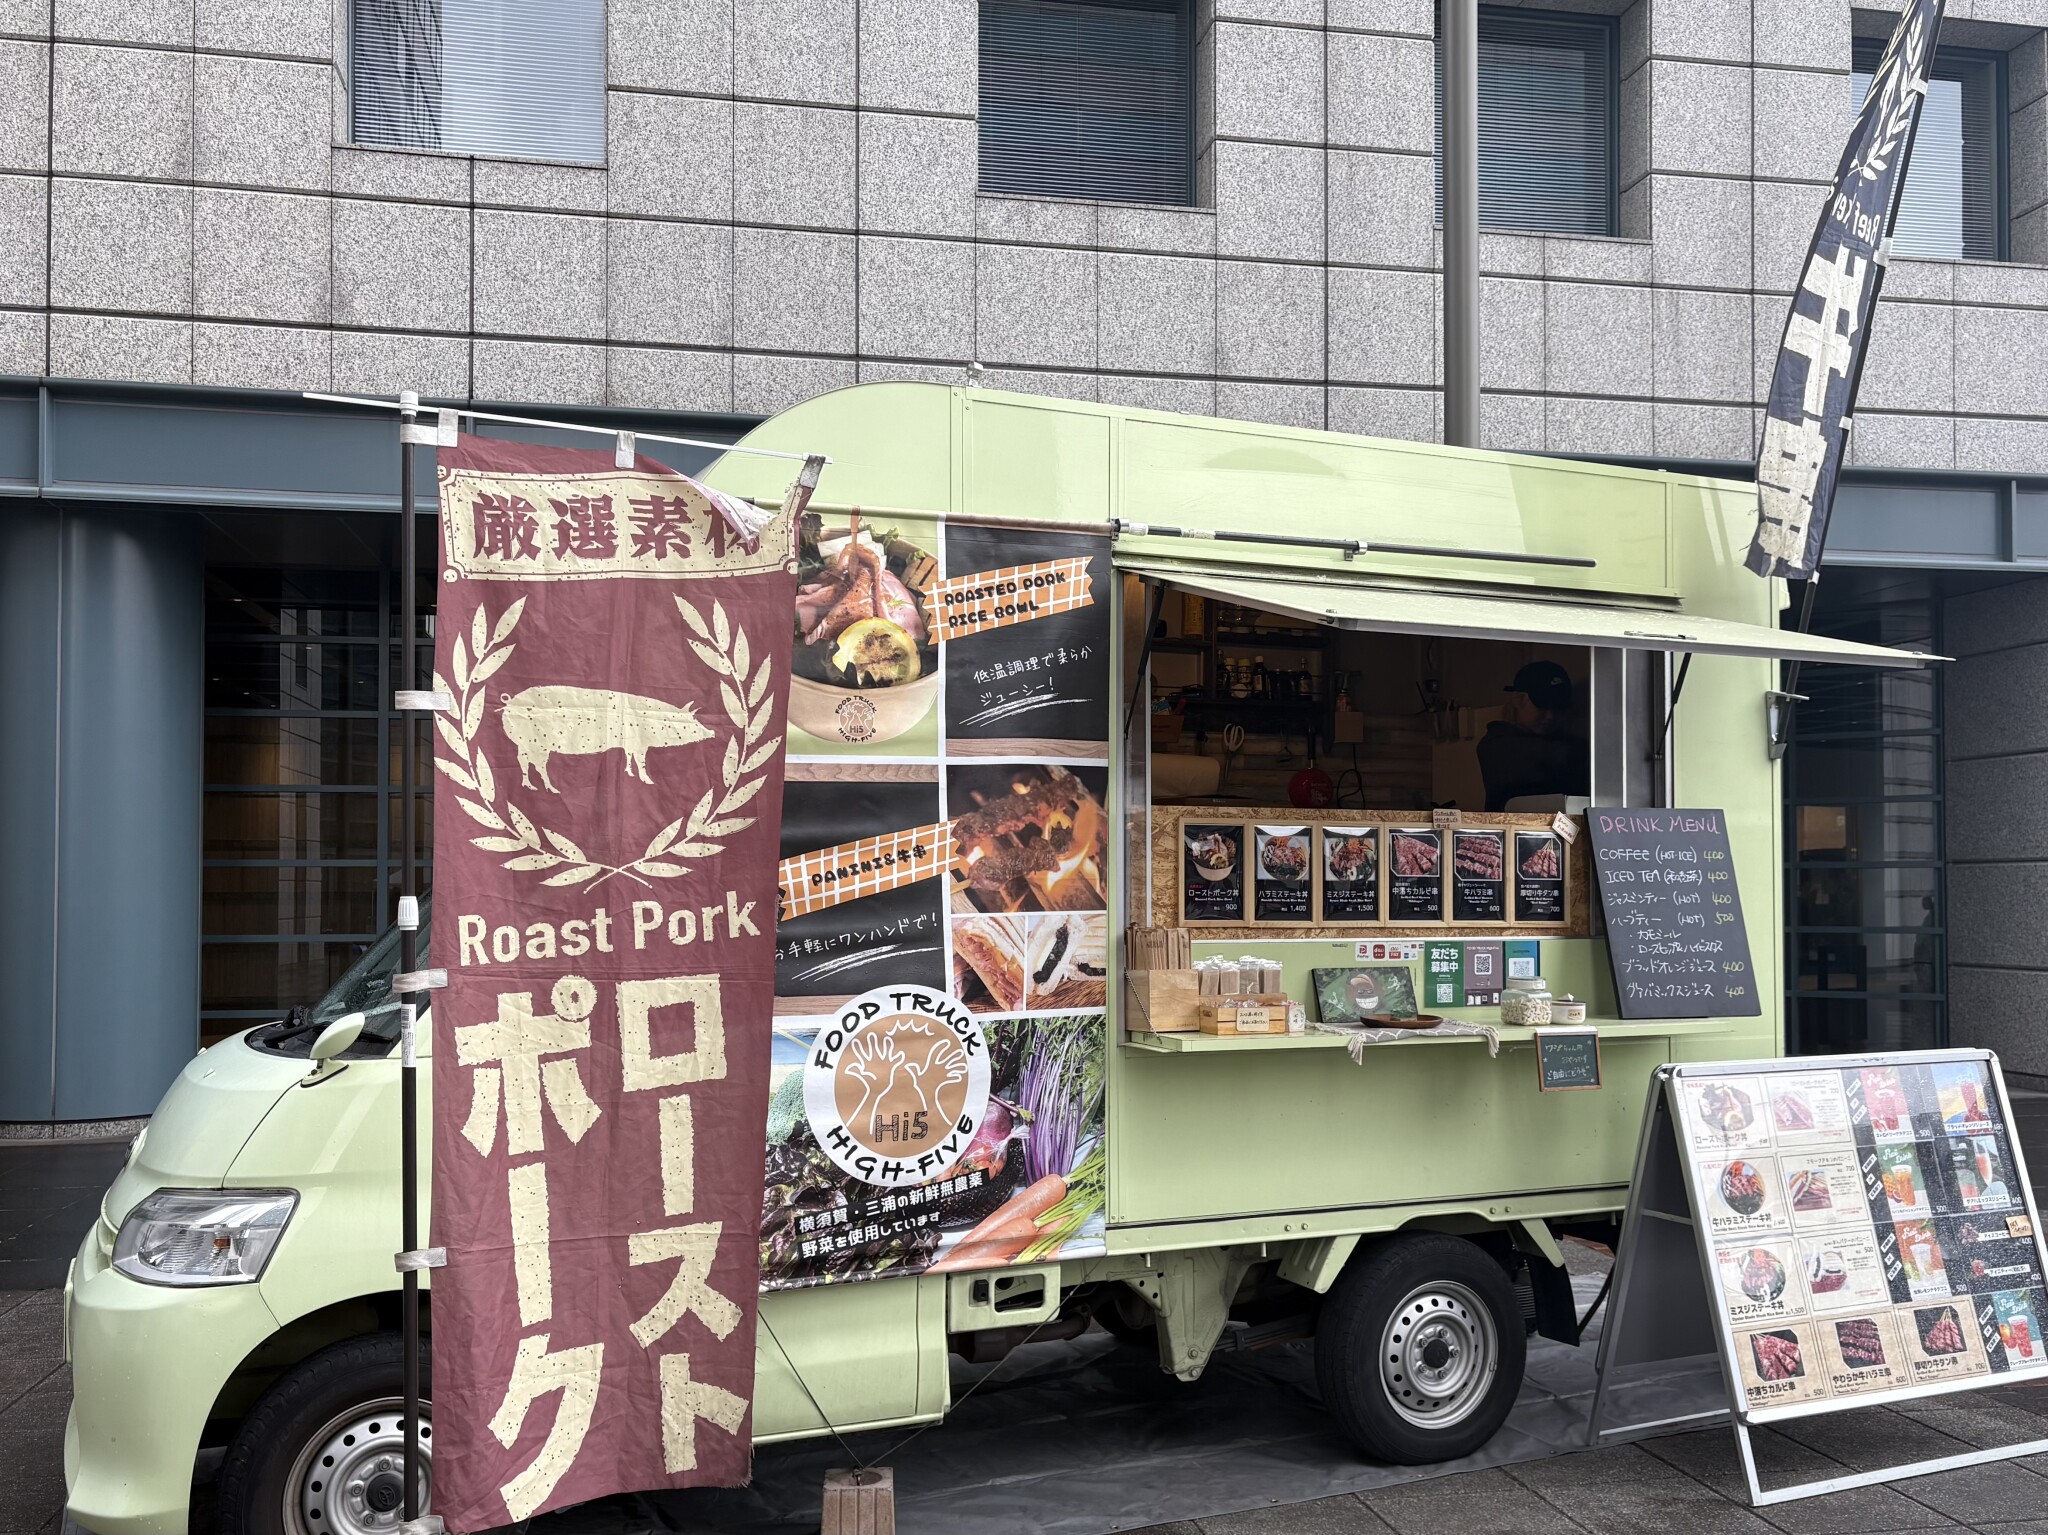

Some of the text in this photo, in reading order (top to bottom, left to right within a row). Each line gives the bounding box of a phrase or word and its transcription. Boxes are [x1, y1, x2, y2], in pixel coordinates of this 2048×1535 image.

[944, 571, 1067, 607] ROASTED PORK
[948, 601, 1040, 629] RICE BOWL
[973, 645, 1093, 684] 低温調理で柔らか
[835, 695, 877, 714] FOOD TRUCK
[1600, 816, 1720, 834] DRINK MENU
[1599, 848, 1650, 860] COFFEE
[1703, 851, 1724, 862] 400
[1605, 871, 1634, 883] ICED
[1638, 869, 1660, 882] TEA
[1708, 871, 1728, 883] 400
[1712, 892, 1732, 905] 400
[458, 890, 761, 967] Roast Pork
[1612, 909, 1661, 926] ハーブティー
[1714, 912, 1734, 924] 500
[1430, 947, 1458, 960] 友だち
[1430, 961, 1458, 973] 募集中
[1622, 959, 1744, 974] ブラッドオレンジジュース 400
[1725, 985, 1744, 998] 400
[814, 992, 981, 1070] FOOD TRUCK
[874, 1111, 928, 1143] Hi5
[827, 1114, 974, 1182] HIGH-FIVE
[799, 1171, 984, 1233] 横須賀・三浦の新鮮無農薬
[616, 974, 750, 1475] ロースト
[801, 1211, 941, 1258] 野菜を使用しています
[455, 974, 605, 1523] ポーク
